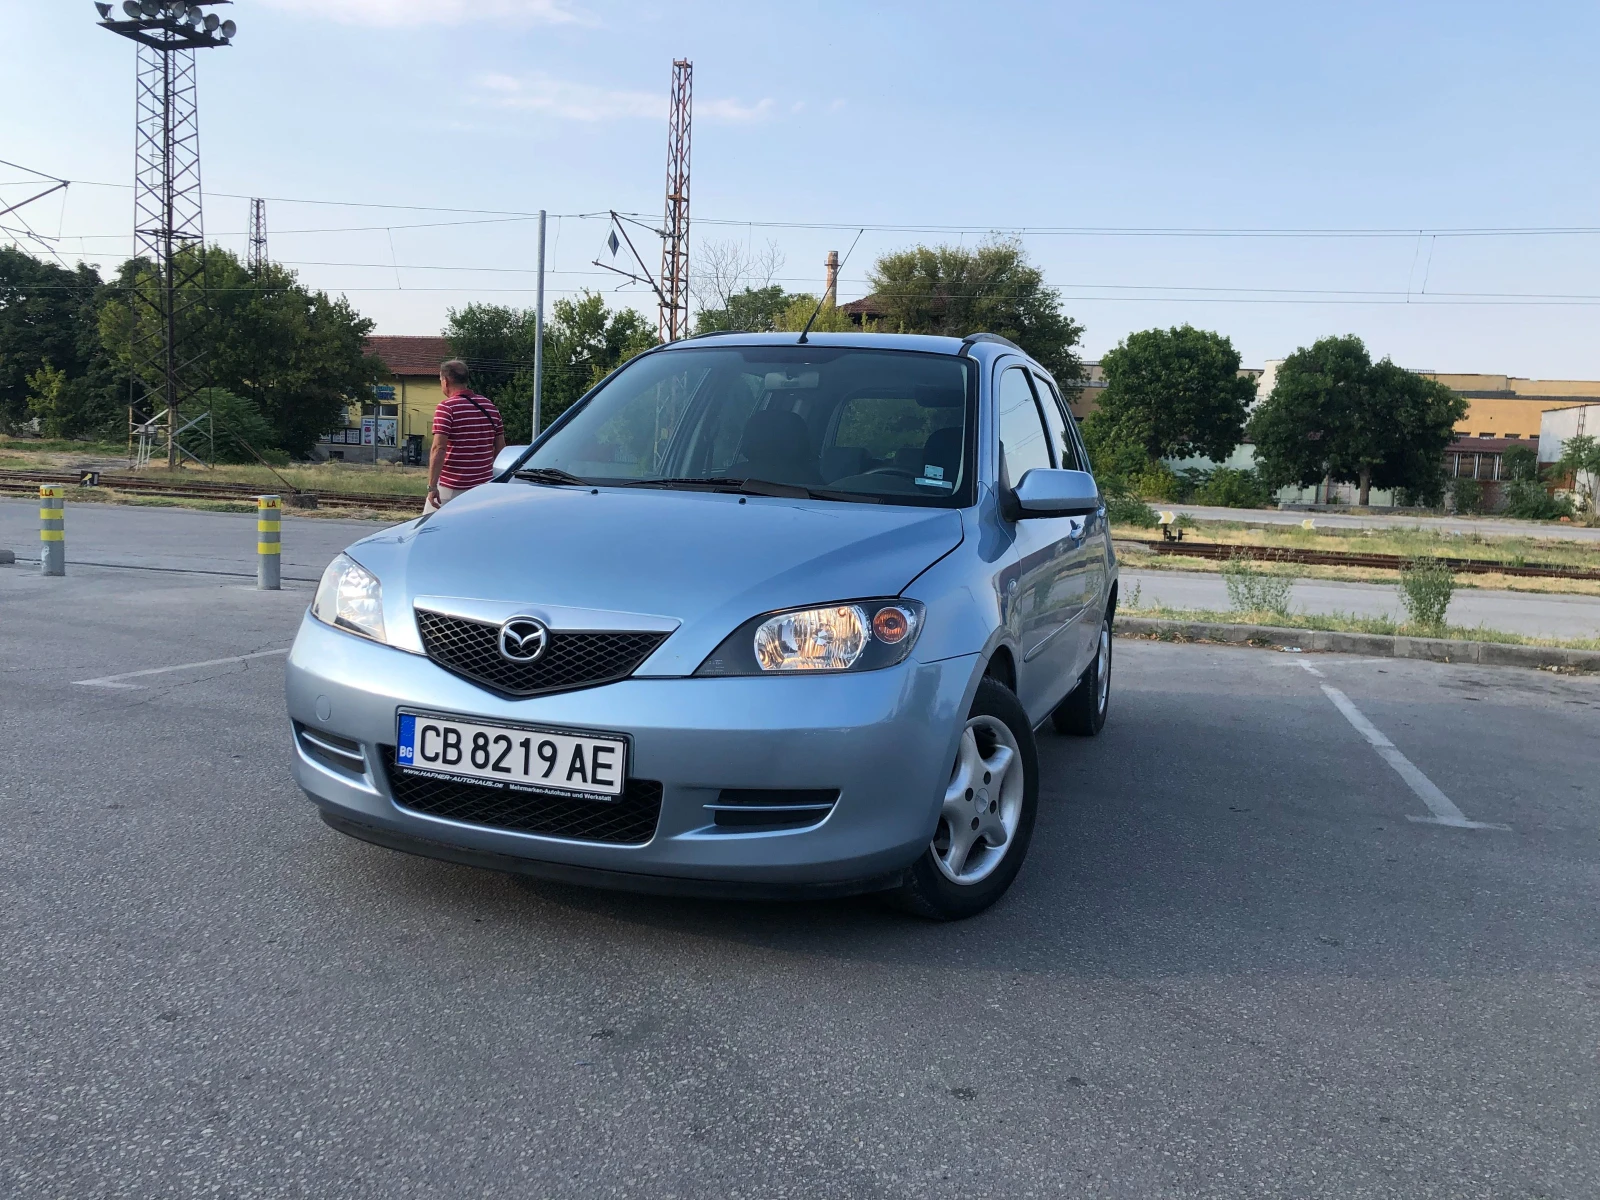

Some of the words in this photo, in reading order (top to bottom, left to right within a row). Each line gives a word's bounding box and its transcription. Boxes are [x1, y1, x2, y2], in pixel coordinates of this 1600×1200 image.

[399, 745, 413, 758] BG
[420, 724, 463, 766] CB
[470, 731, 558, 779] 8219
[566, 743, 616, 787] AE
[584, 792, 612, 801] Werkstatt
